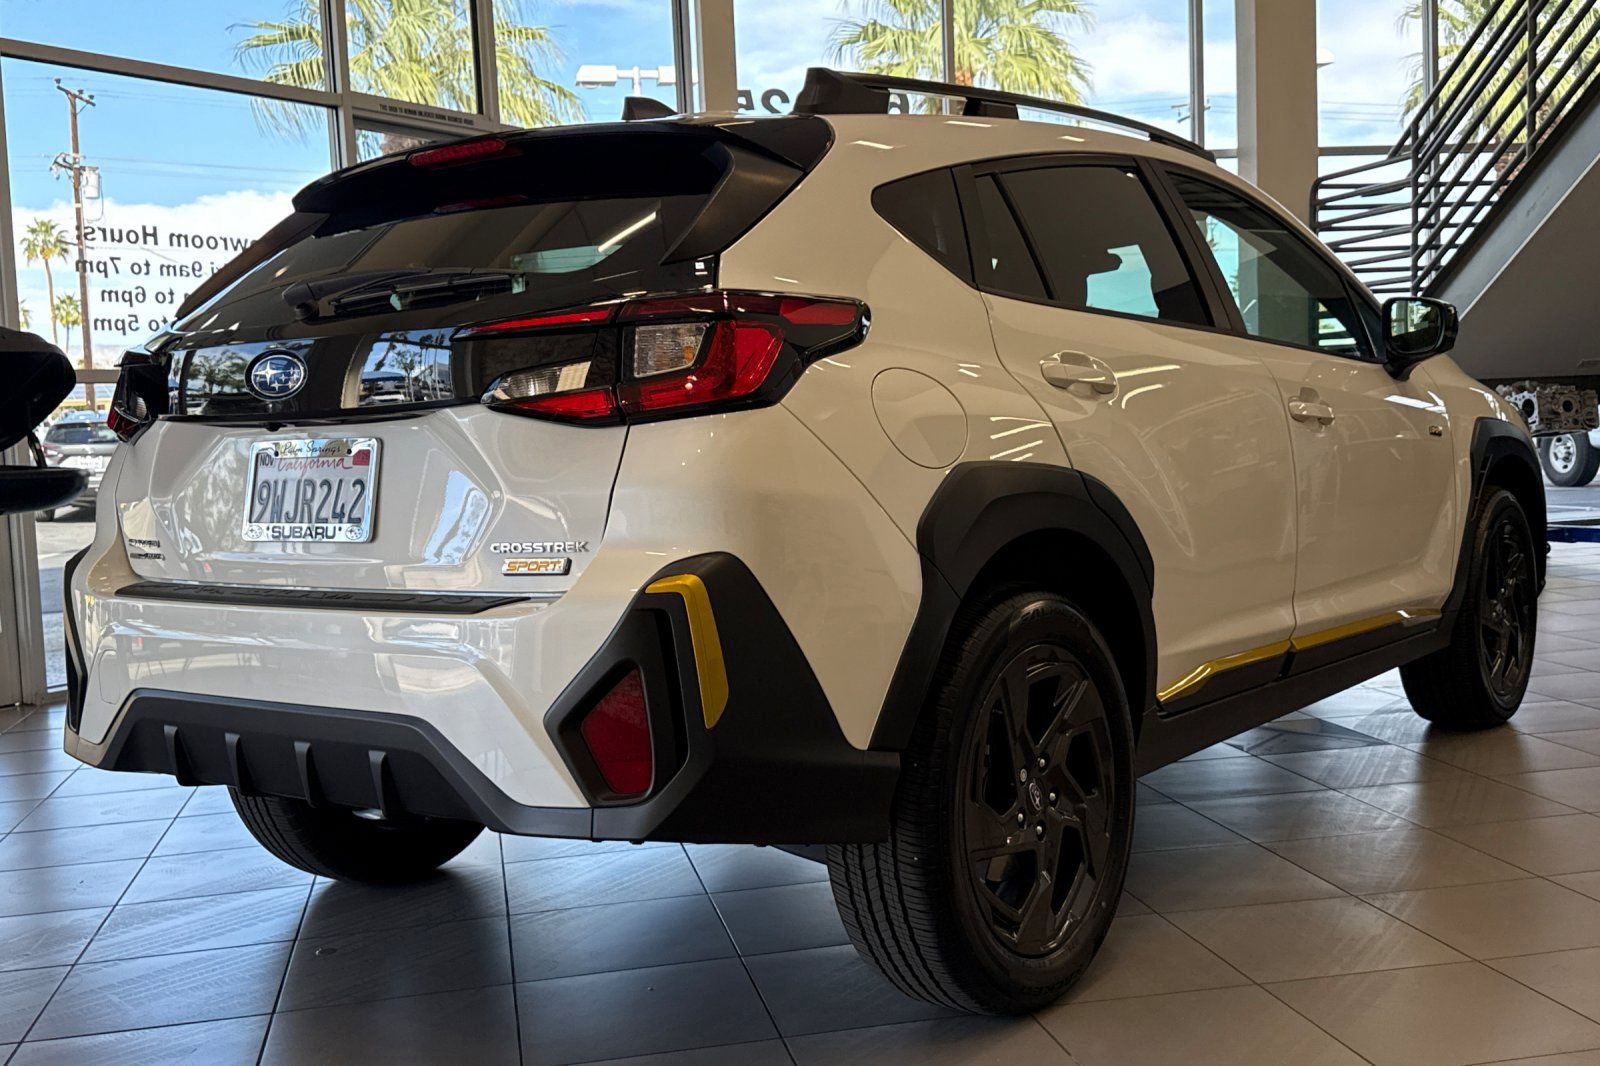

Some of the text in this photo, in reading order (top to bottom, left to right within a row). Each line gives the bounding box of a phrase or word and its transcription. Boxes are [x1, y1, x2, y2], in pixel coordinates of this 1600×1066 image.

[282, 440, 341, 455] Palm Springs
[260, 454, 273, 467] NOV
[278, 457, 353, 478] California
[253, 478, 366, 523] 9WJR242
[271, 526, 337, 540] SUBARU
[490, 541, 589, 554] CROSSTREK
[506, 560, 562, 572] SPORT
